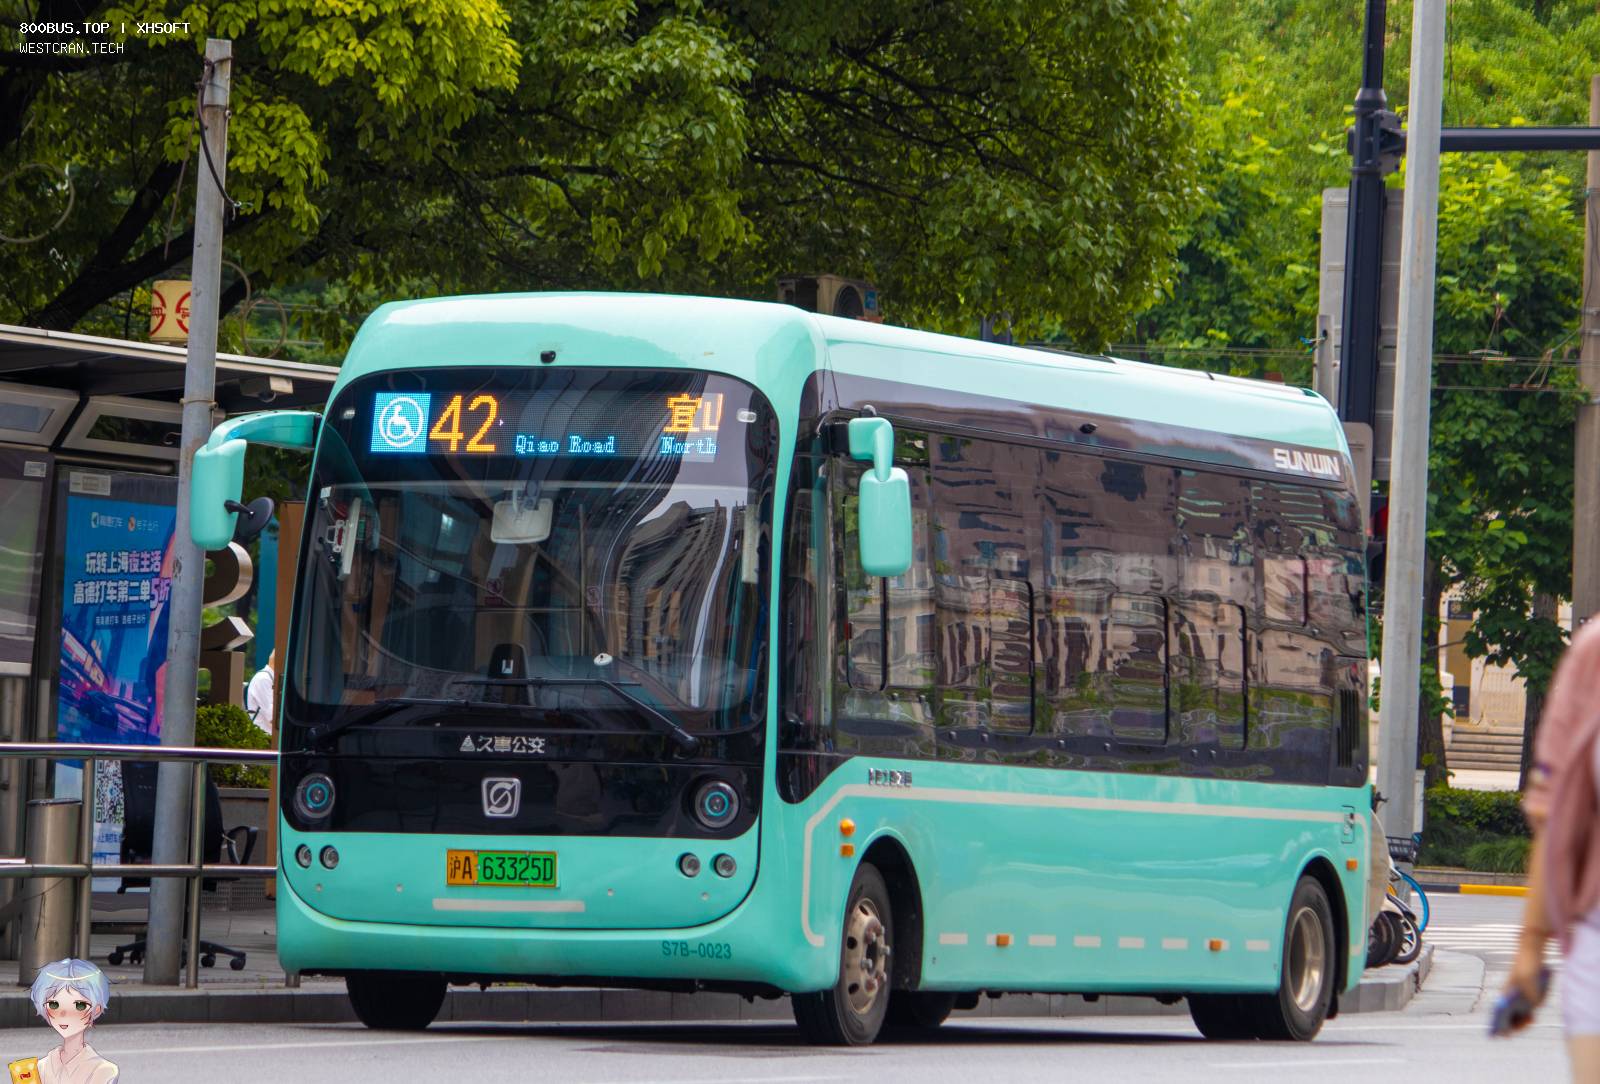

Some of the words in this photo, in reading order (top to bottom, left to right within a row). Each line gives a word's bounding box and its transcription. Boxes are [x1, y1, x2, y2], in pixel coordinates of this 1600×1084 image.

[429, 395, 498, 452] 42
[1273, 448, 1341, 476] SUNWIN
[85, 550, 162, 574] 玩转上海夜生活
[482, 856, 554, 882] 63325D
[662, 940, 732, 960] S7B-0023
